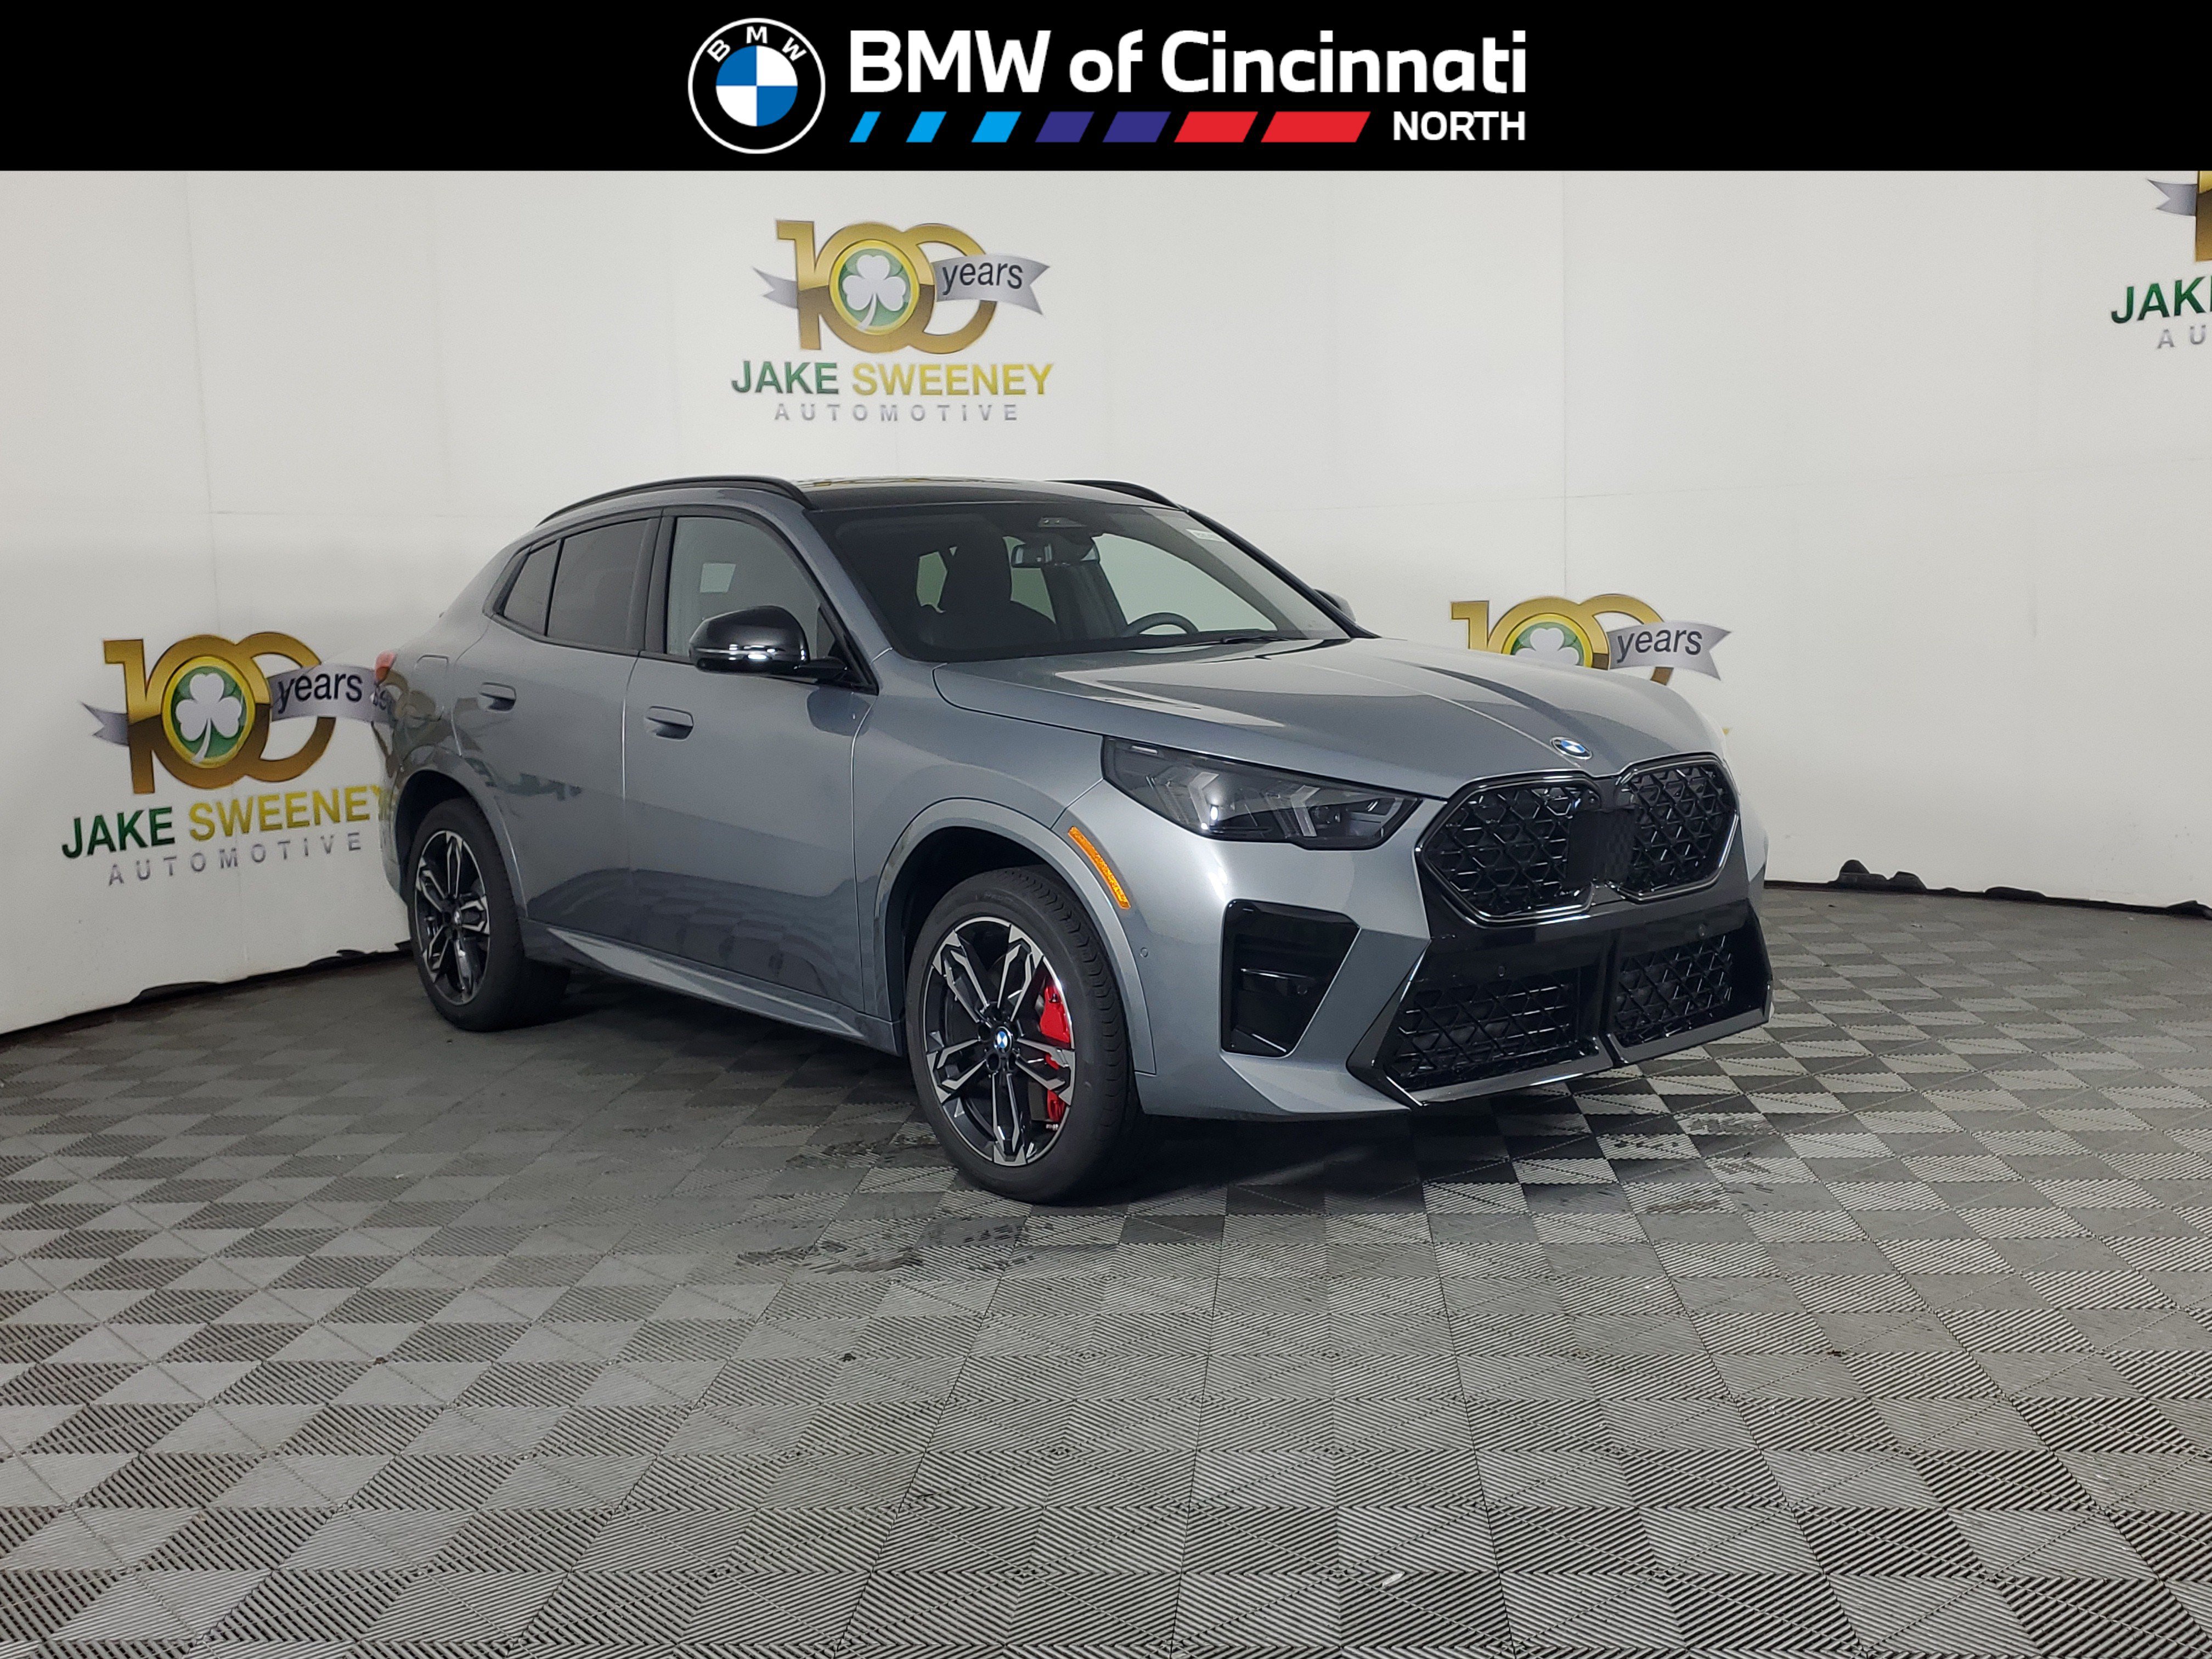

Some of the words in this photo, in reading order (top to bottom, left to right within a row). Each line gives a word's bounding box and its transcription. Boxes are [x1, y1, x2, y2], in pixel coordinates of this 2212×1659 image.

[775, 219, 997, 354] 100
[941, 262, 1024, 296] years
[2111, 274, 2212, 324] JAK
[731, 360, 839, 394] JAKE
[852, 363, 1054, 396] SWEENEY
[774, 403, 1018, 422] AUTOMOTIVE
[1616, 629, 1703, 663] years
[103, 631, 336, 794] 100
[278, 672, 363, 713] years
[61, 806, 176, 859] JAKE
[109, 832, 362, 887] AUTOMOTIVE
